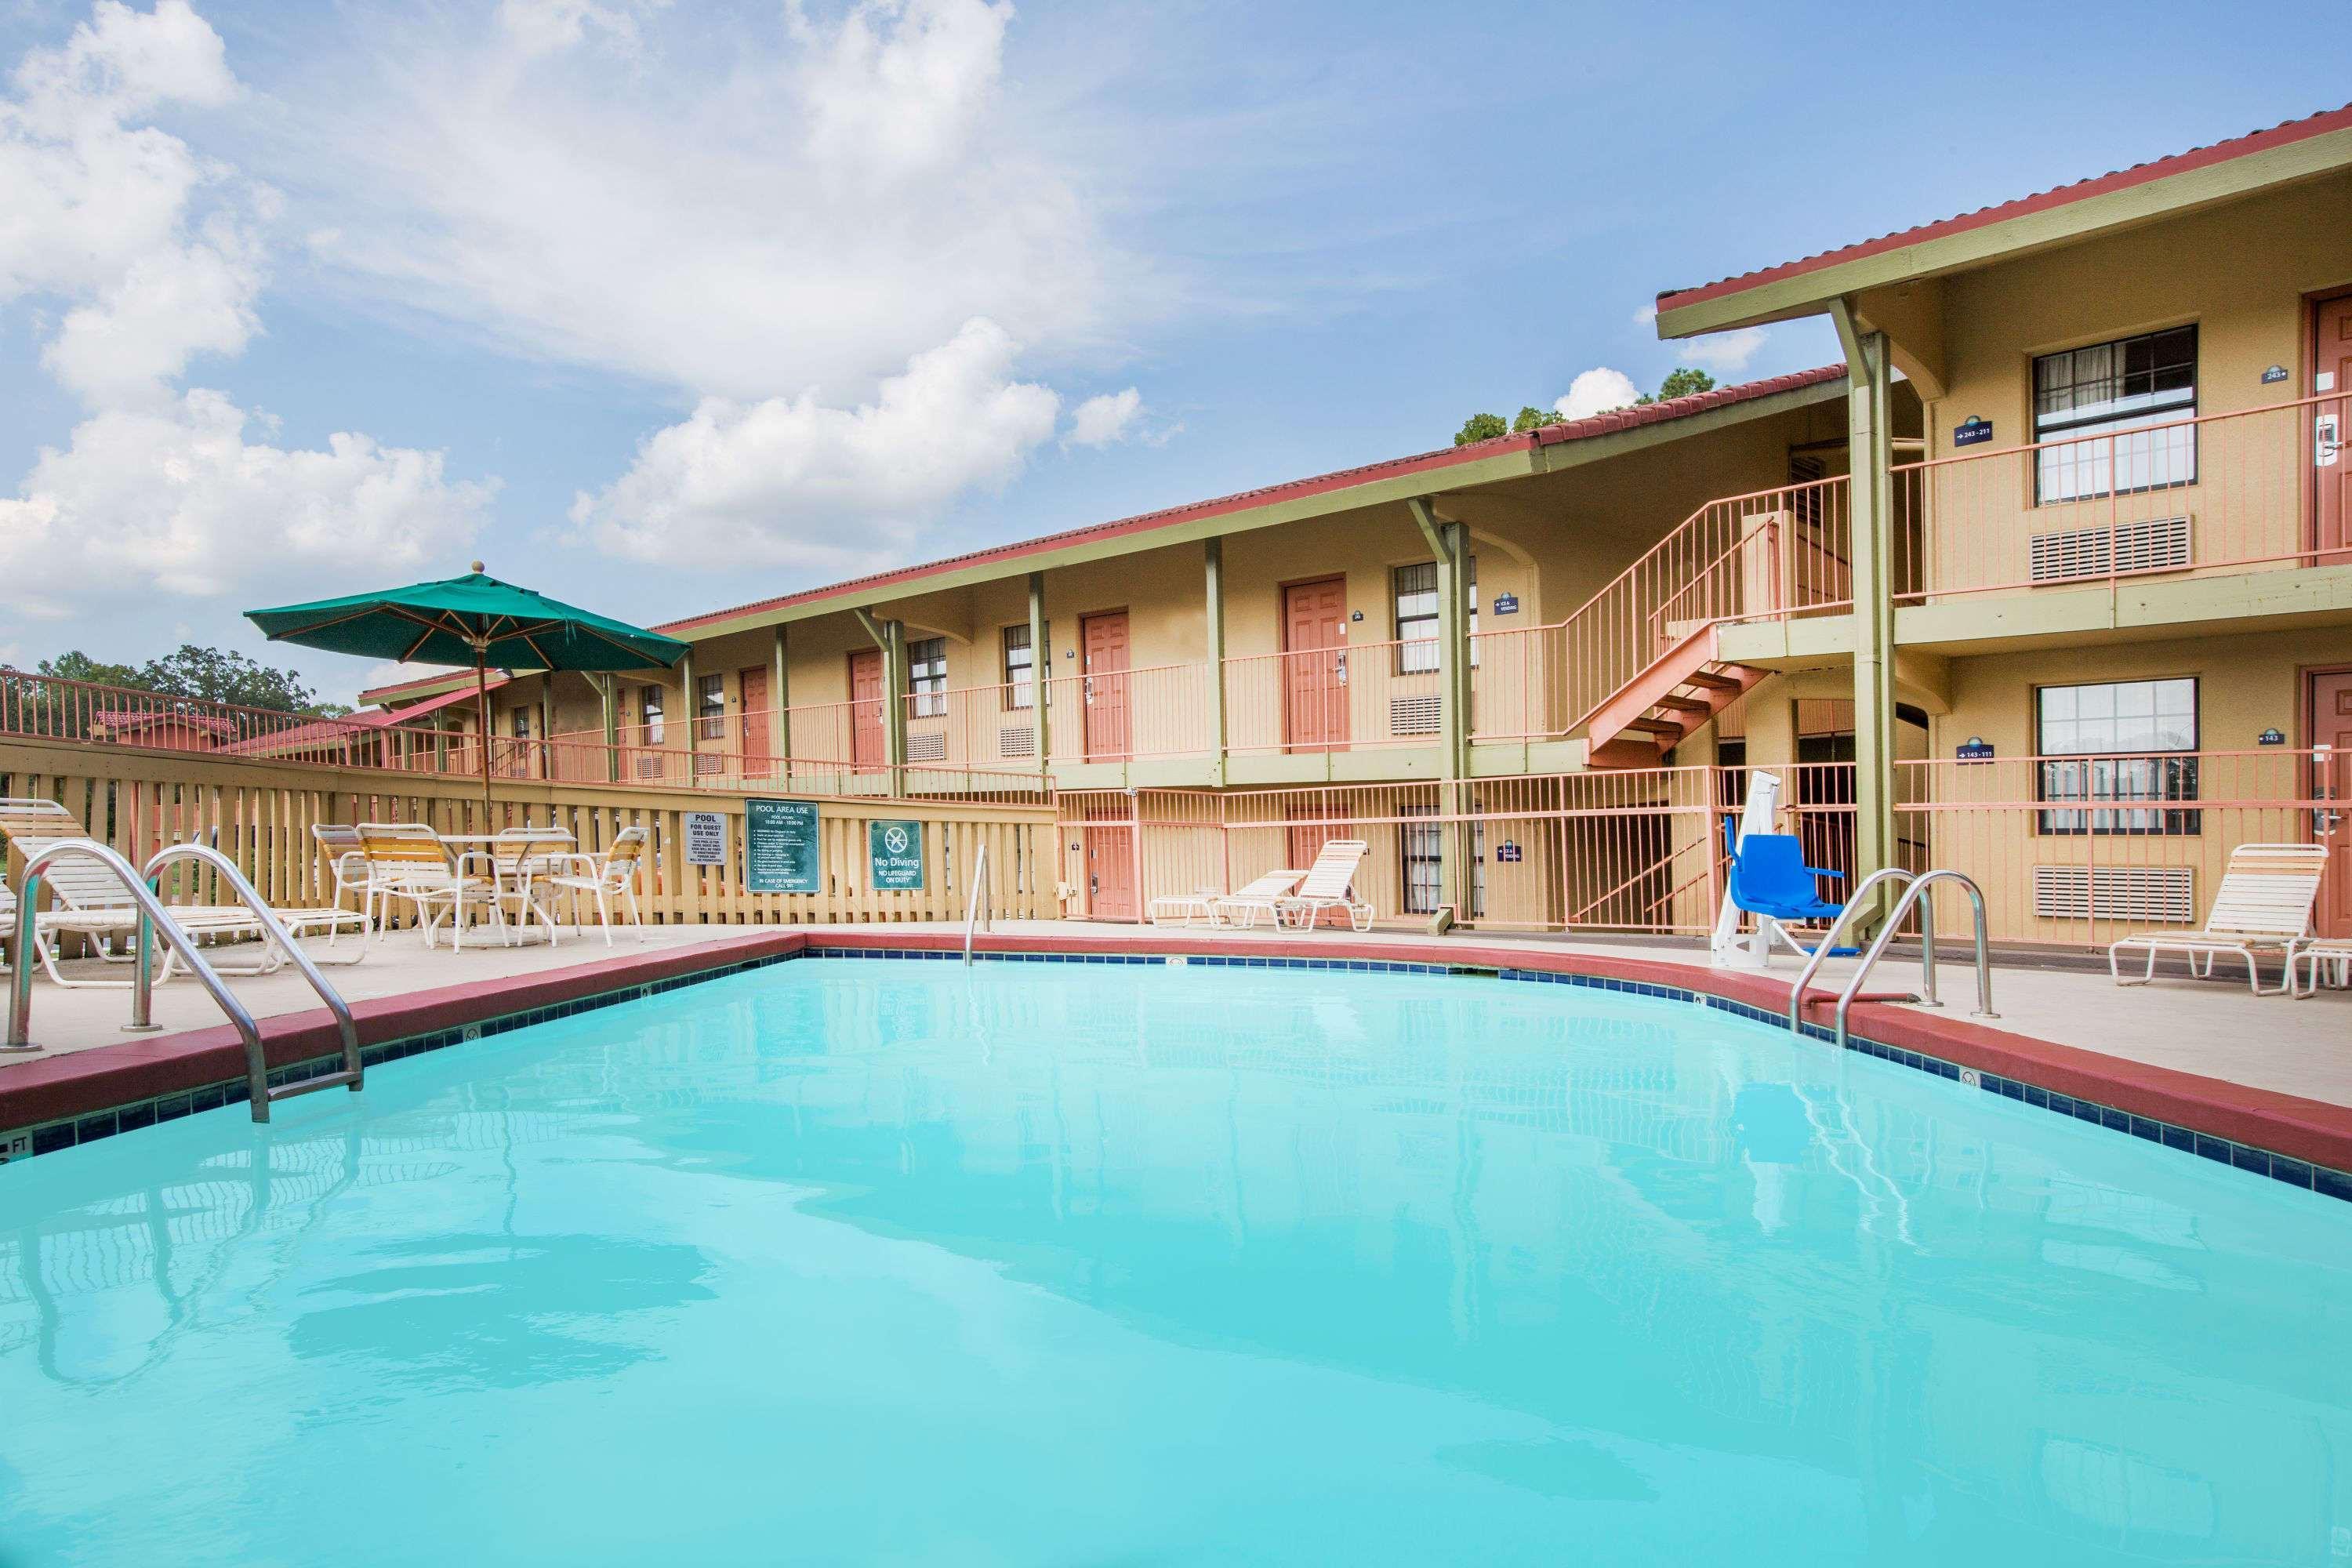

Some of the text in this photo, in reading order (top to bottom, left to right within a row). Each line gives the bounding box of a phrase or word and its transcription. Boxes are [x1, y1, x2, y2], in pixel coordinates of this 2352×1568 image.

[874, 857, 919, 869] No Diving
[12, 1136, 27, 1153] FT
